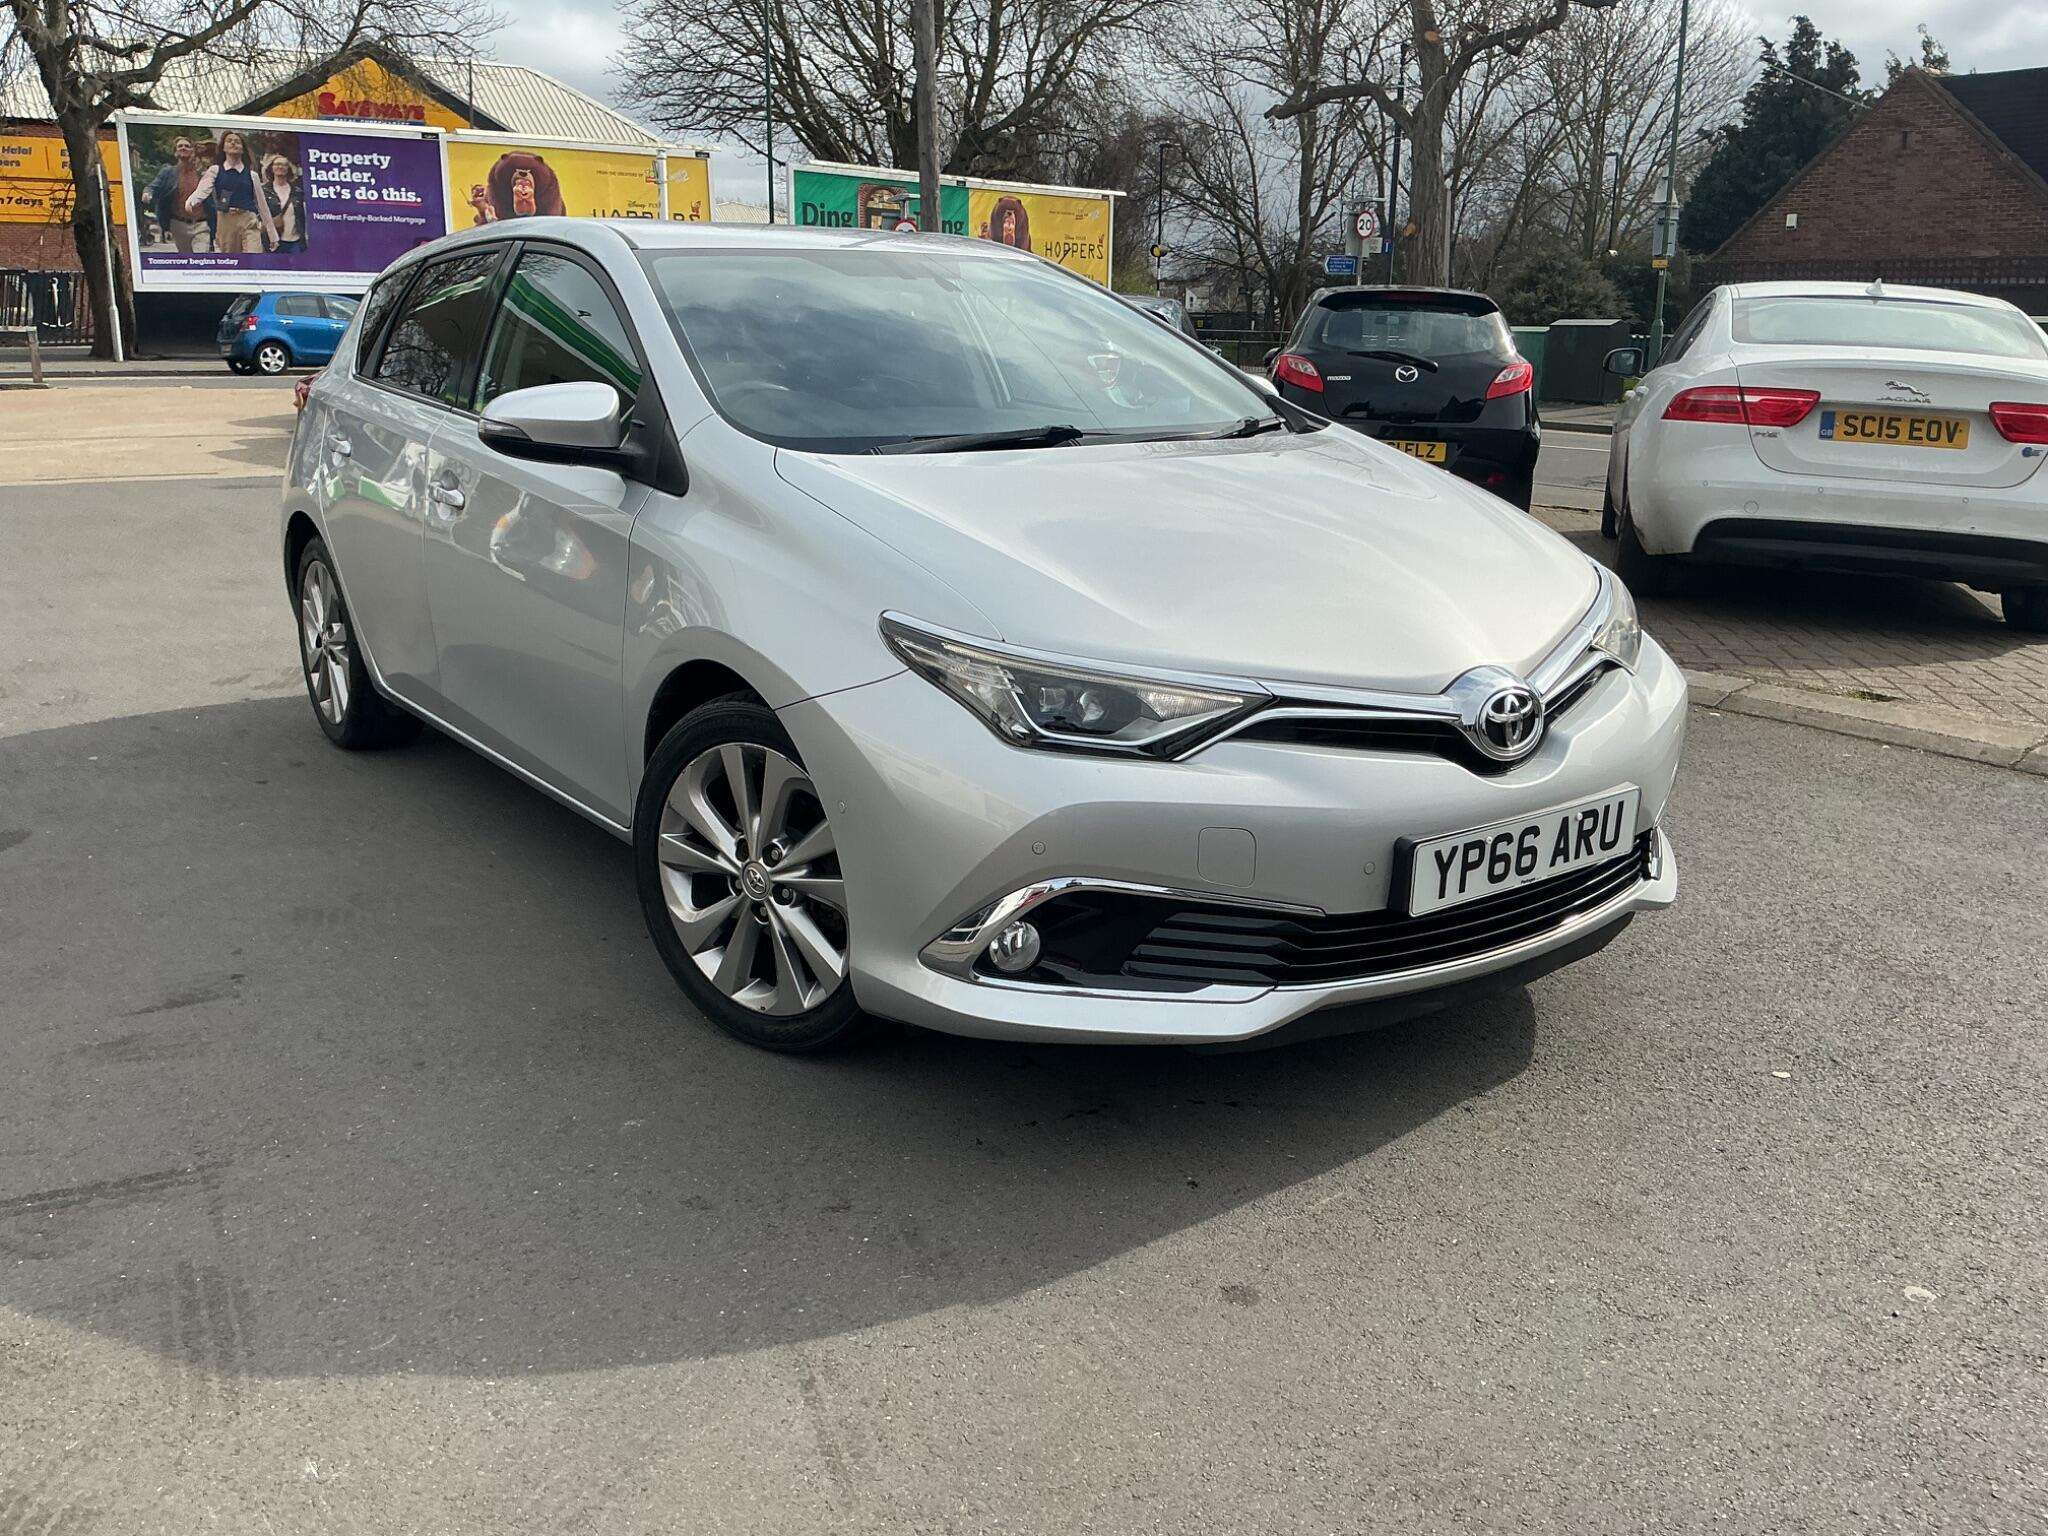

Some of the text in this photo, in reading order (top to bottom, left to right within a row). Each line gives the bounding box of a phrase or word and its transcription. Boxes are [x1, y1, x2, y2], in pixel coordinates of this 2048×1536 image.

[308, 149, 391, 169] Property
[309, 166, 376, 185] ladder,
[15, 197, 44, 207] days
[311, 184, 422, 202] let's do this.
[313, 212, 426, 225] NatWest Family-Backed Mortgage
[801, 202, 854, 227] Ding
[1359, 219, 1372, 231] 20
[1044, 241, 1104, 261] HOPPERS
[148, 257, 239, 266] Tomorrow begins today
[1843, 414, 1960, 444] SC15 EOV
[1434, 800, 1625, 900] YP66 ARU
